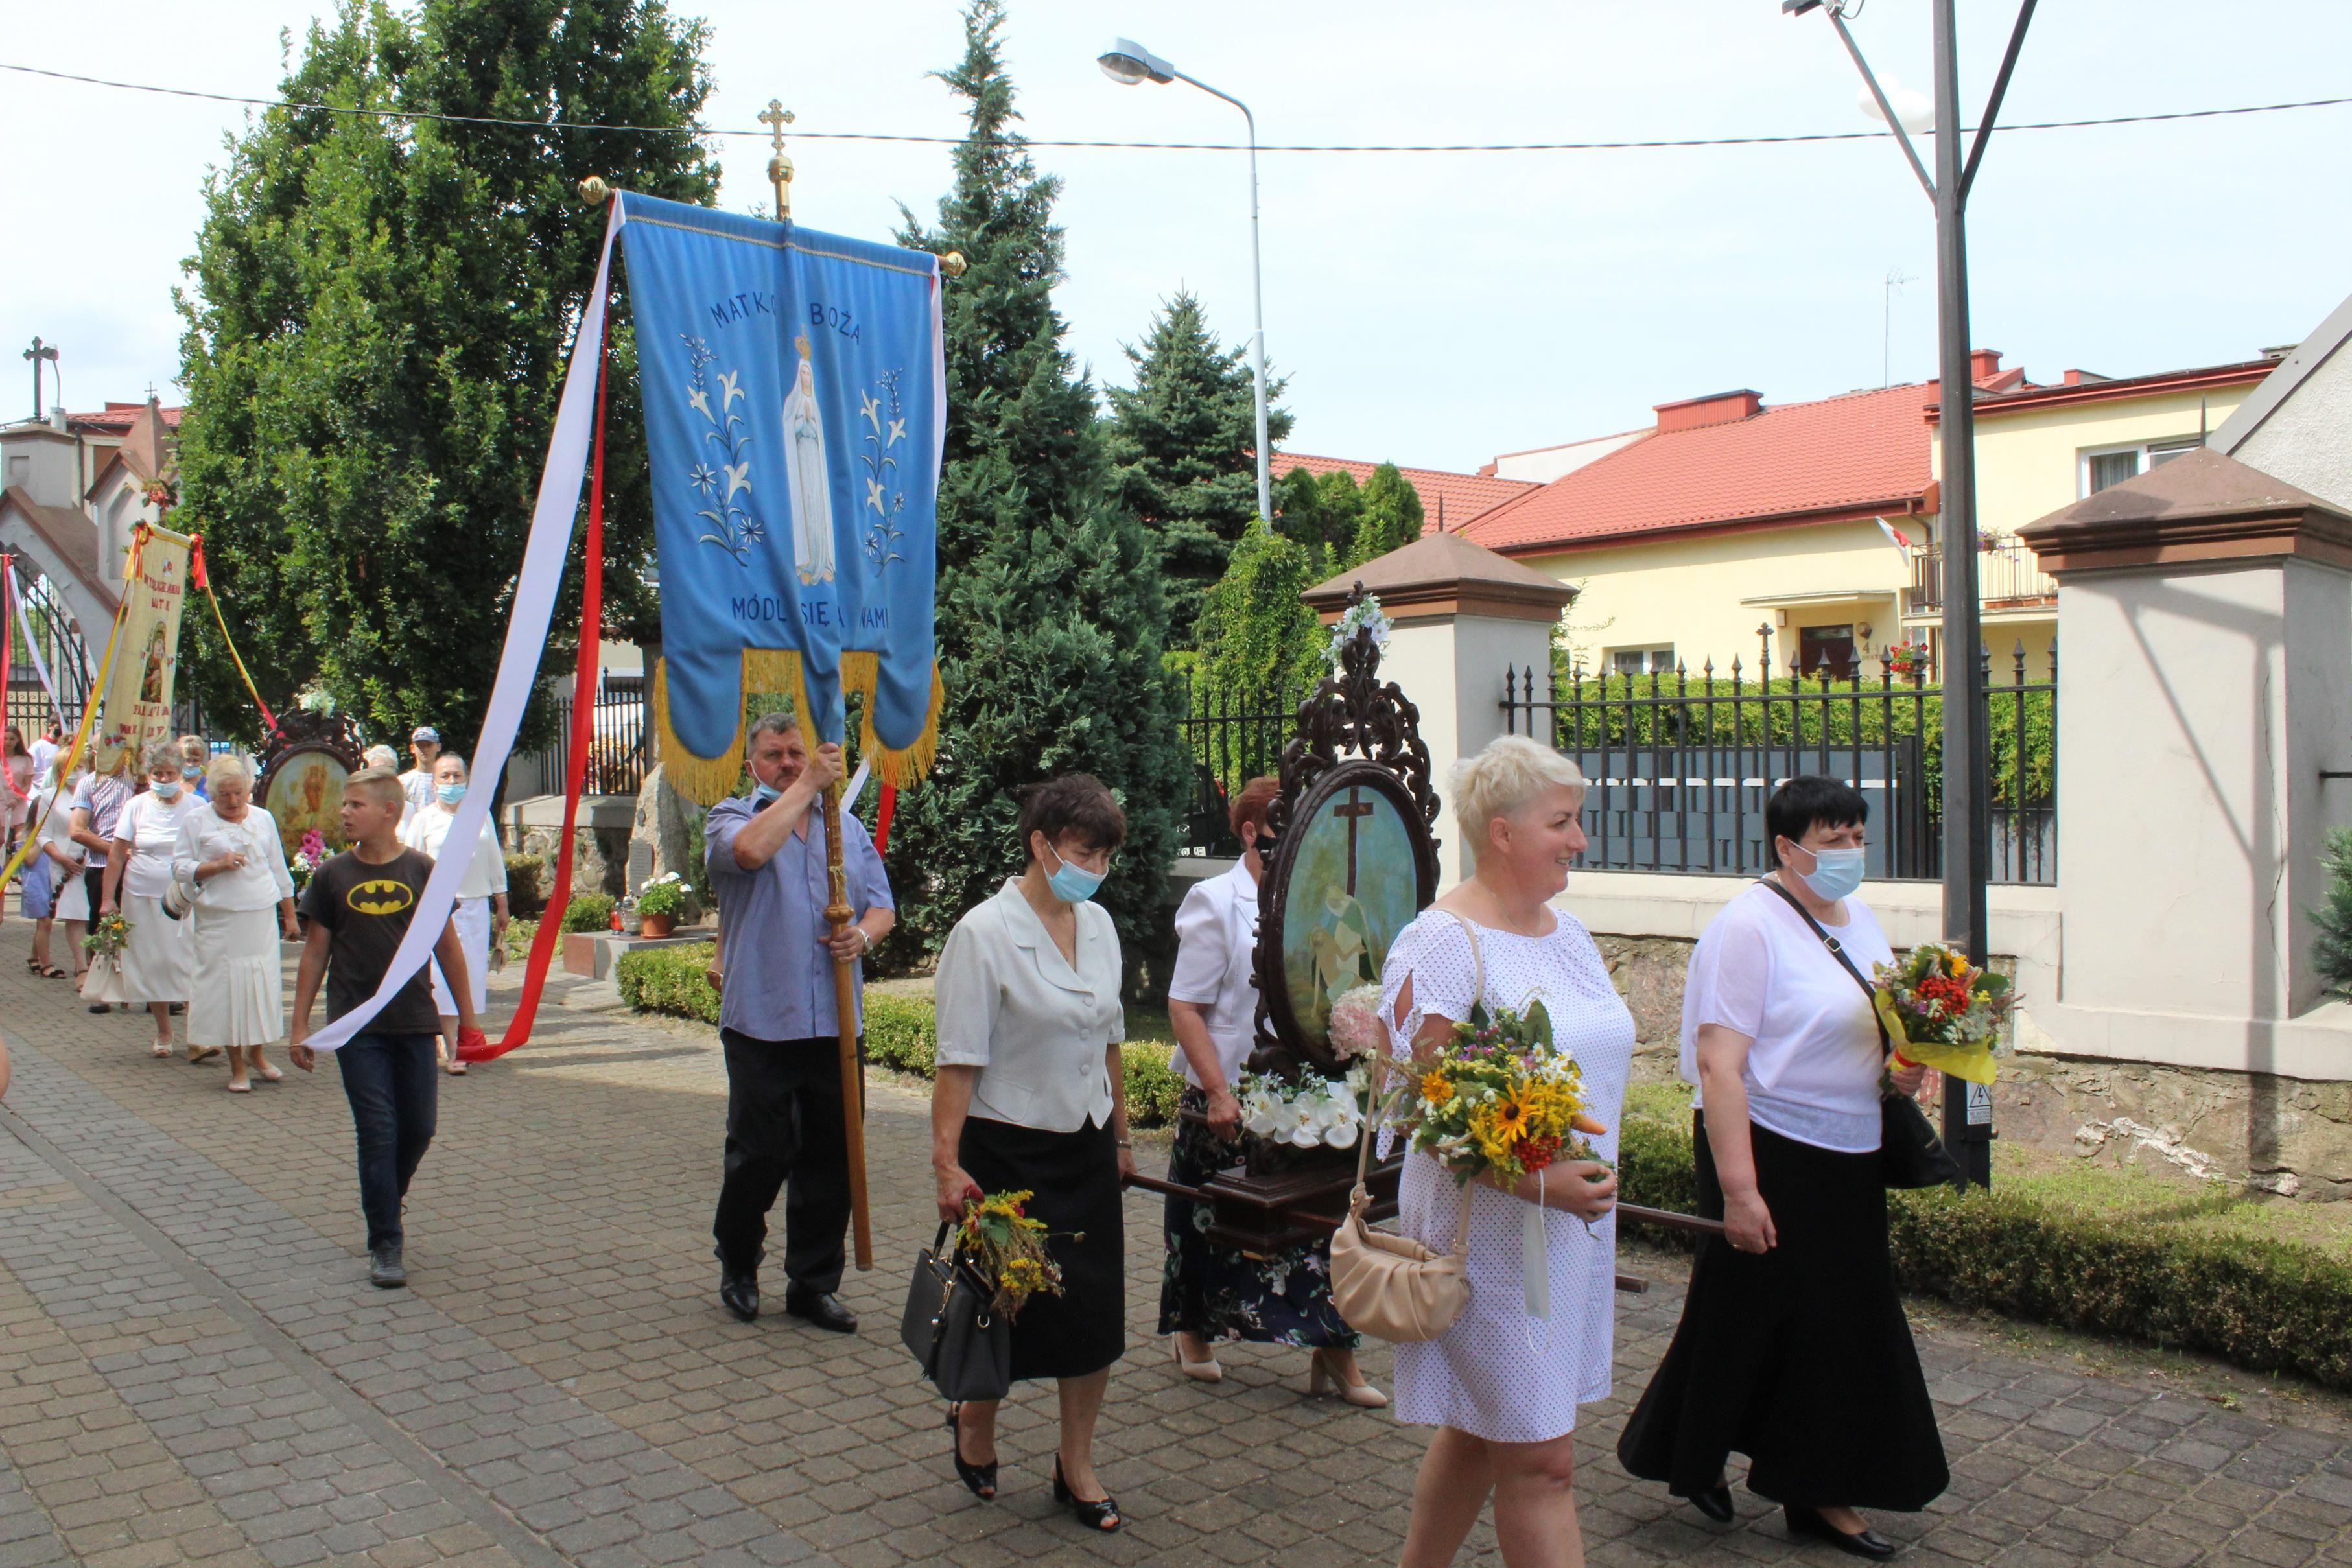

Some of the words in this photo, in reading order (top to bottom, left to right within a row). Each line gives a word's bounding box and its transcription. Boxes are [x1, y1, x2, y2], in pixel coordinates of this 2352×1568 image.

[810, 303, 860, 345] BOŻA
[732, 593, 786, 622] MÓDL
[801, 602, 830, 627] SIĘ
[859, 607, 888, 629] NAMI
